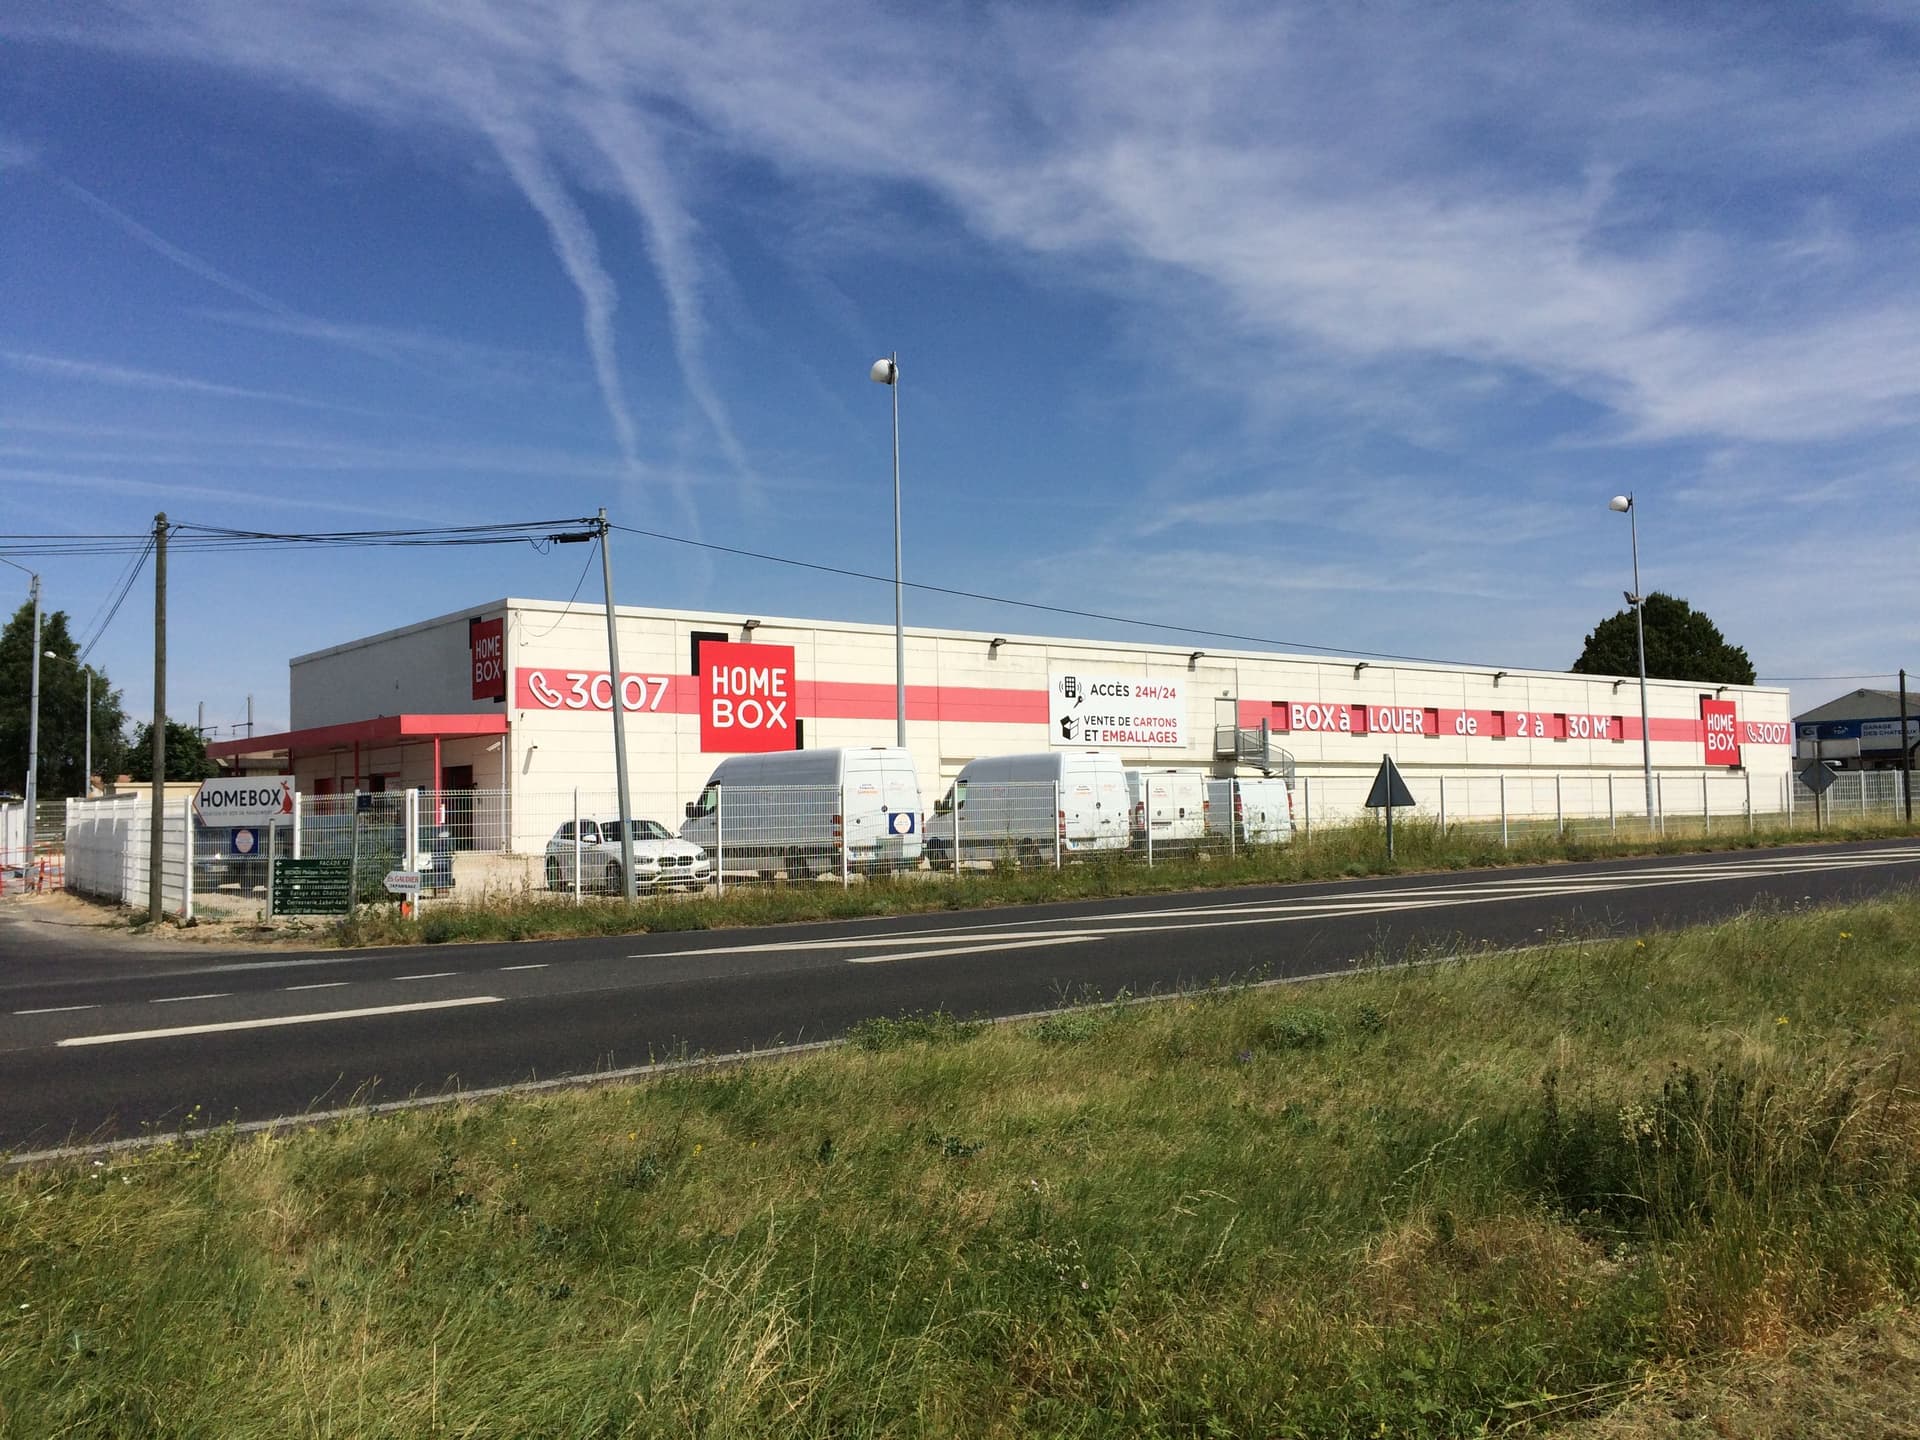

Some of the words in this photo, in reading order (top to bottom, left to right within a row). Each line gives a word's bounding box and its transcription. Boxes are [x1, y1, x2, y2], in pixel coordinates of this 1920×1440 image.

[475, 635, 501, 659] HOME
[475, 660, 501, 683] BOX
[712, 665, 787, 697] HOME
[565, 673, 669, 711] 3007
[1090, 681, 1130, 697] ACCÈS
[1135, 686, 1176, 700] 24H/24
[712, 698, 787, 729] BOX
[1084, 715, 1115, 726] VENTE
[1118, 716, 1131, 727] DE
[1133, 716, 1177, 728] CARTONS
[1291, 704, 1336, 730] BOX
[1339, 707, 1350, 732] à
[1369, 708, 1423, 733] LOUER
[1455, 712, 1477, 735] de
[1517, 713, 1527, 737] 2
[1535, 714, 1545, 737] à
[1568, 716, 1589, 738] 30
[1707, 713, 1734, 732] HOME
[1084, 730, 1099, 742] ET
[1102, 730, 1178, 743] EMBALLAGES
[1708, 733, 1736, 751] BOX
[1757, 724, 1787, 743] 3007
[201, 789, 281, 807] HOMEBOX
